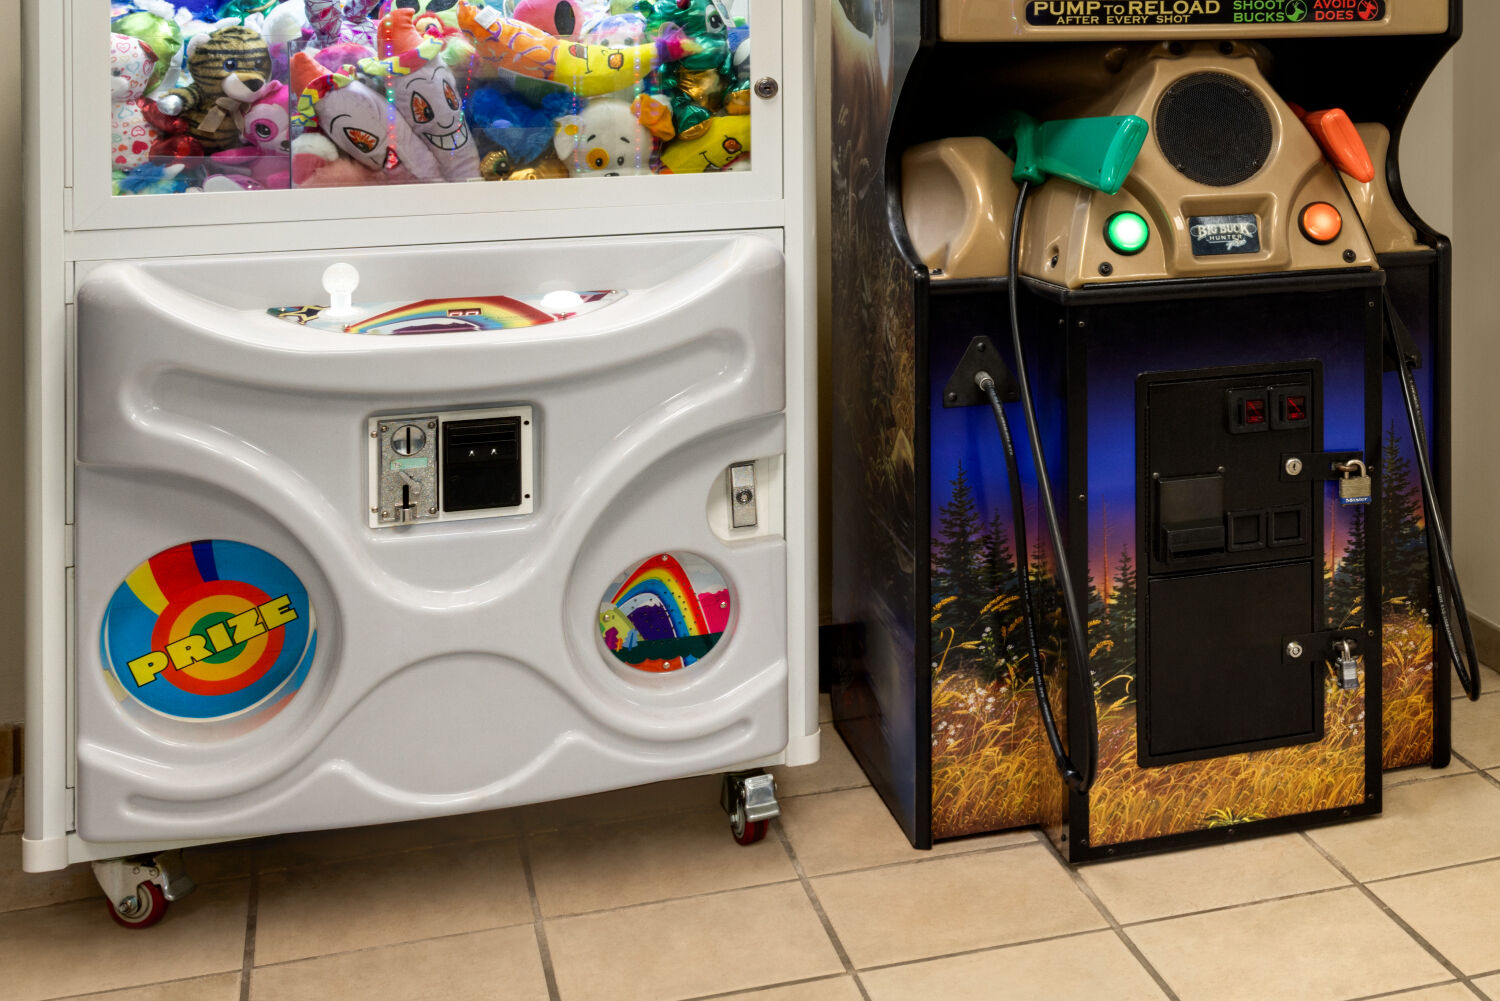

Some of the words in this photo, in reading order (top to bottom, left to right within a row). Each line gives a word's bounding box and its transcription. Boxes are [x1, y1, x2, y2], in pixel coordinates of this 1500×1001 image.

[1034, 1, 1101, 15] PUMP
[1129, 0, 1220, 15] RELOAD
[1233, 0, 1283, 11] SHOOT
[1056, 15, 1099, 25] AFTER
[1107, 15, 1148, 24] EVERY
[1156, 14, 1190, 24] SHOT
[1233, 11, 1284, 23] BUCKS
[1315, 10, 1354, 21] DOES
[1197, 224, 1218, 240] BIG
[1220, 222, 1254, 238] BUCK
[127, 593, 299, 688] PRIZE
